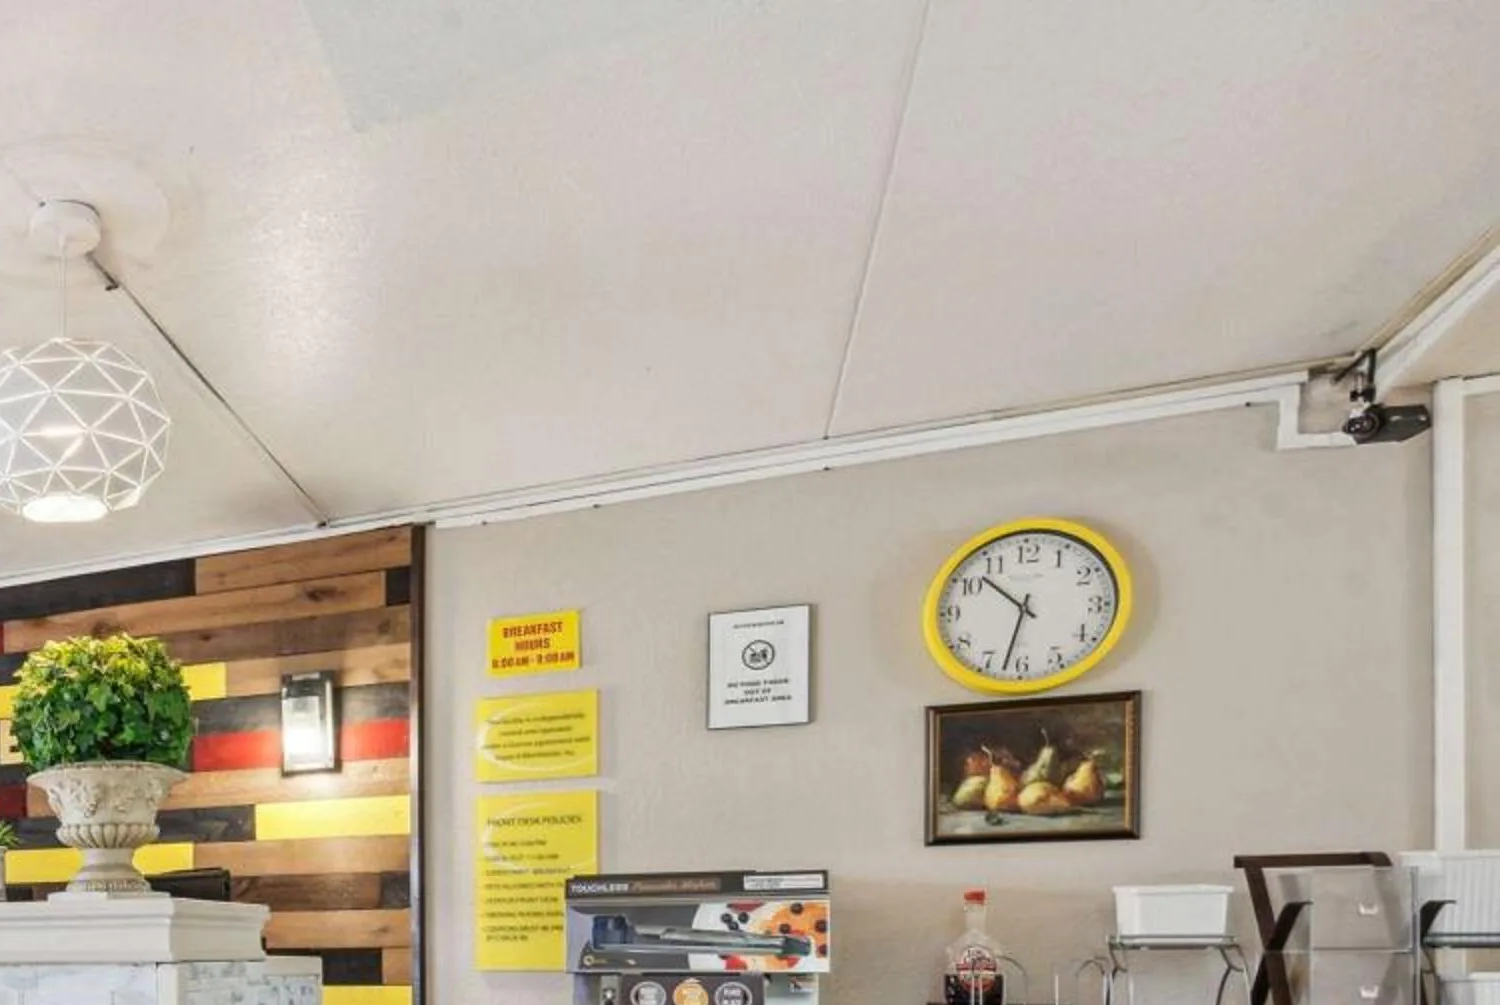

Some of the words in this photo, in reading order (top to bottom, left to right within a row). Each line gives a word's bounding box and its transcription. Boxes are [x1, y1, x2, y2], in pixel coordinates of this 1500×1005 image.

[1017, 545, 1040, 564] 12
[1055, 550, 1062, 568] 1
[985, 555, 1004, 574] 11
[1076, 566, 1092, 586] 2
[961, 577, 983, 596] 10
[947, 605, 961, 623] 9
[1088, 596, 1103, 614] 3
[503, 621, 563, 638] BREAKFAST
[1072, 623, 1087, 642] 4
[957, 632, 972, 649] 8
[982, 650, 996, 669] 7
[1015, 655, 1029, 673] 6
[1048, 646, 1063, 665] 5
